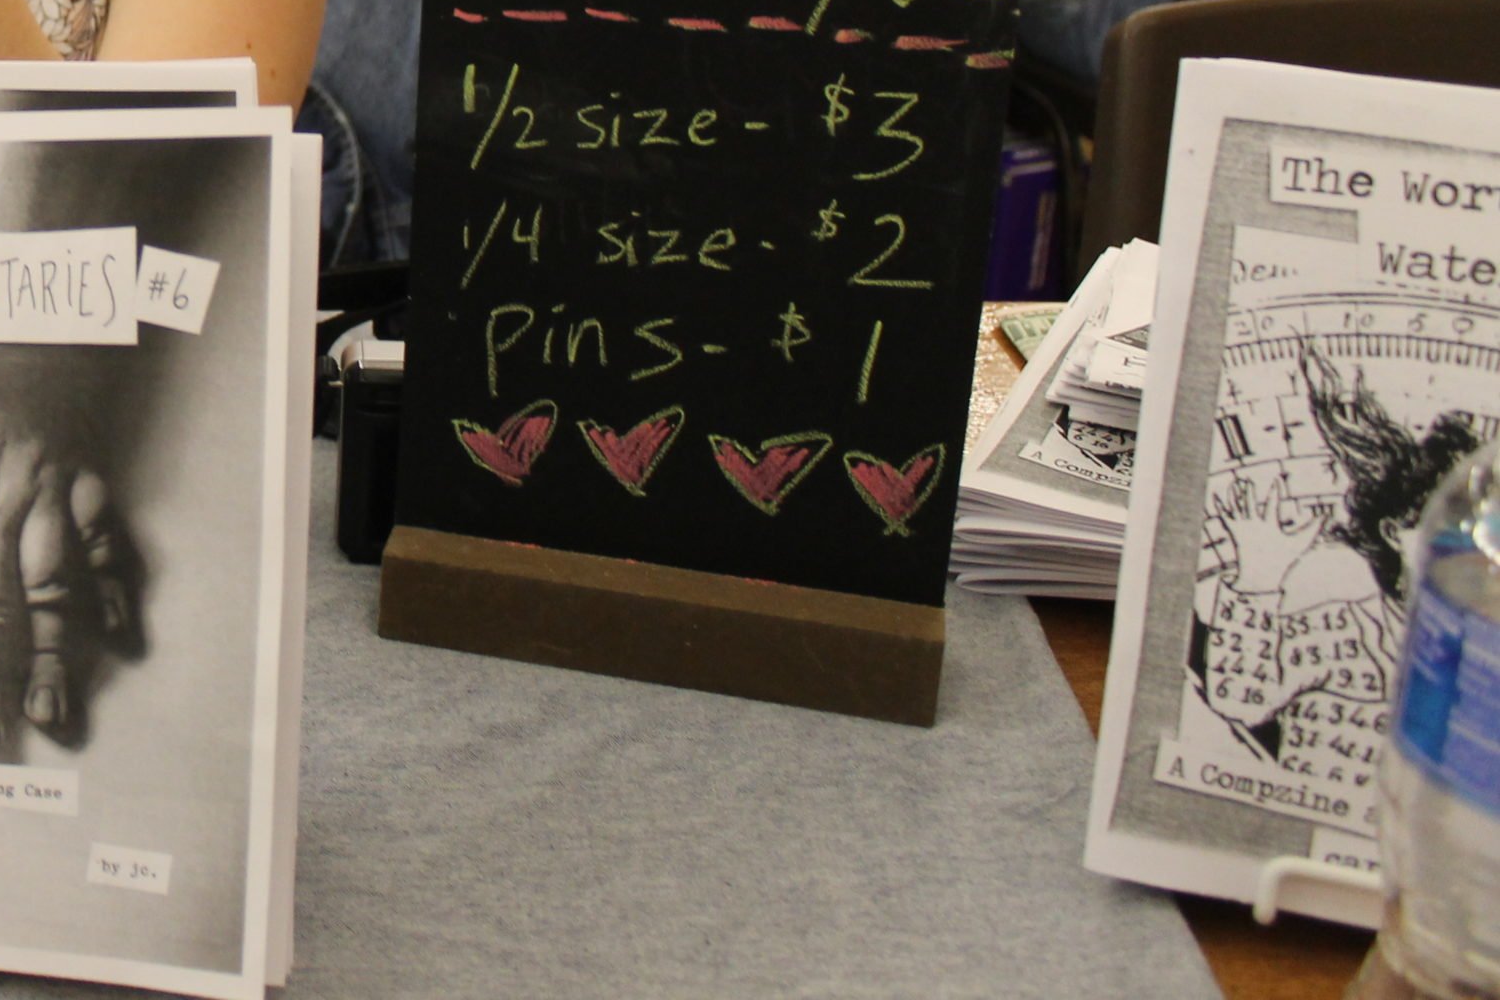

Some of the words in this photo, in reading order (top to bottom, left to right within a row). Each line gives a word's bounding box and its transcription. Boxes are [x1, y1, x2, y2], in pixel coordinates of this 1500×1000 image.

[463, 62, 548, 170] 1/2
[1282, 155, 1375, 198] The
[1401, 169, 1500, 212] Wor
[460, 200, 543, 290] 1/4
[1377, 240, 1500, 286] Wate
[148, 267, 190, 311] #6
[1031, 450, 1043, 461] A
[1054, 459, 1132, 487] Compzi
[24, 783, 63, 801] Case
[1167, 756, 1185, 780] A
[1200, 762, 1350, 817] Compzine
[100, 858, 120, 877] by
[129, 862, 158, 879] jc.
